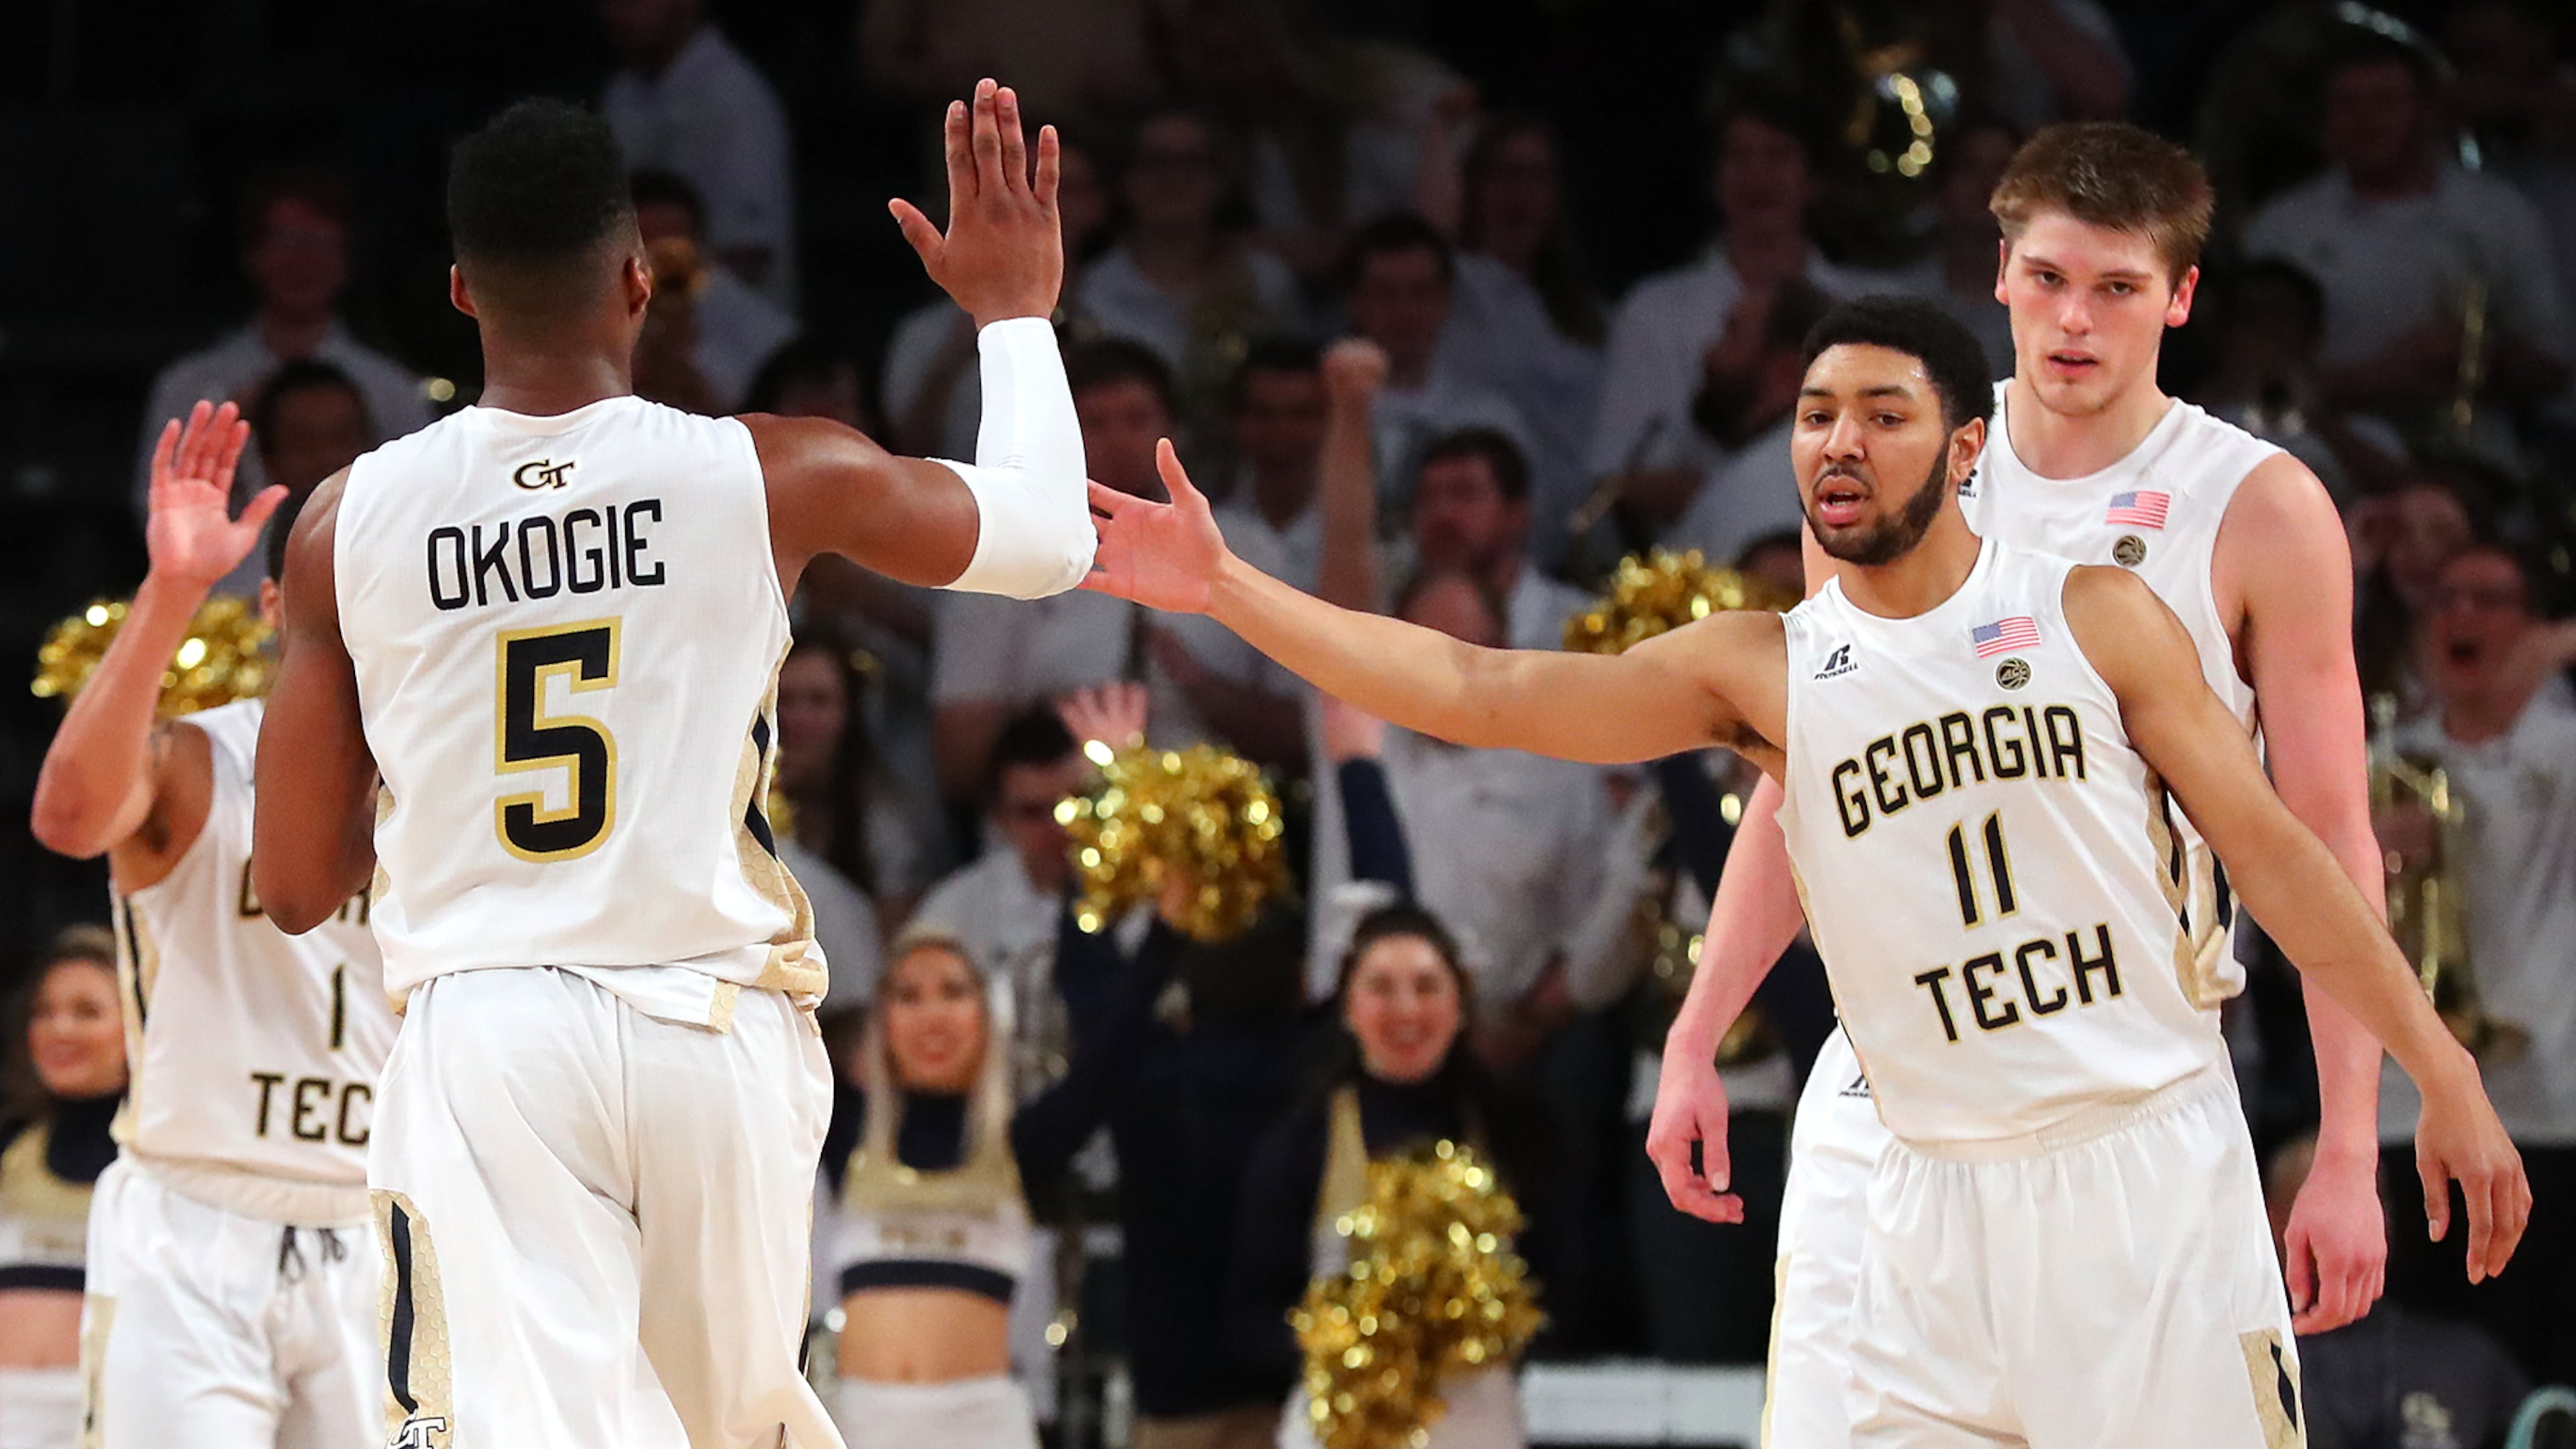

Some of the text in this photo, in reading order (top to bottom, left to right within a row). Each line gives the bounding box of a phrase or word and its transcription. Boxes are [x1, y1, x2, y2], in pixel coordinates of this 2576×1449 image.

[513, 458, 575, 490] GT
[427, 498, 665, 611] OKOGIE
[494, 615, 622, 863] 5
[1831, 704, 2088, 841] GEORGIA
[1946, 808, 2019, 930] 11
[329, 963, 345, 1051] 1
[1913, 922, 2123, 1044] TECH
